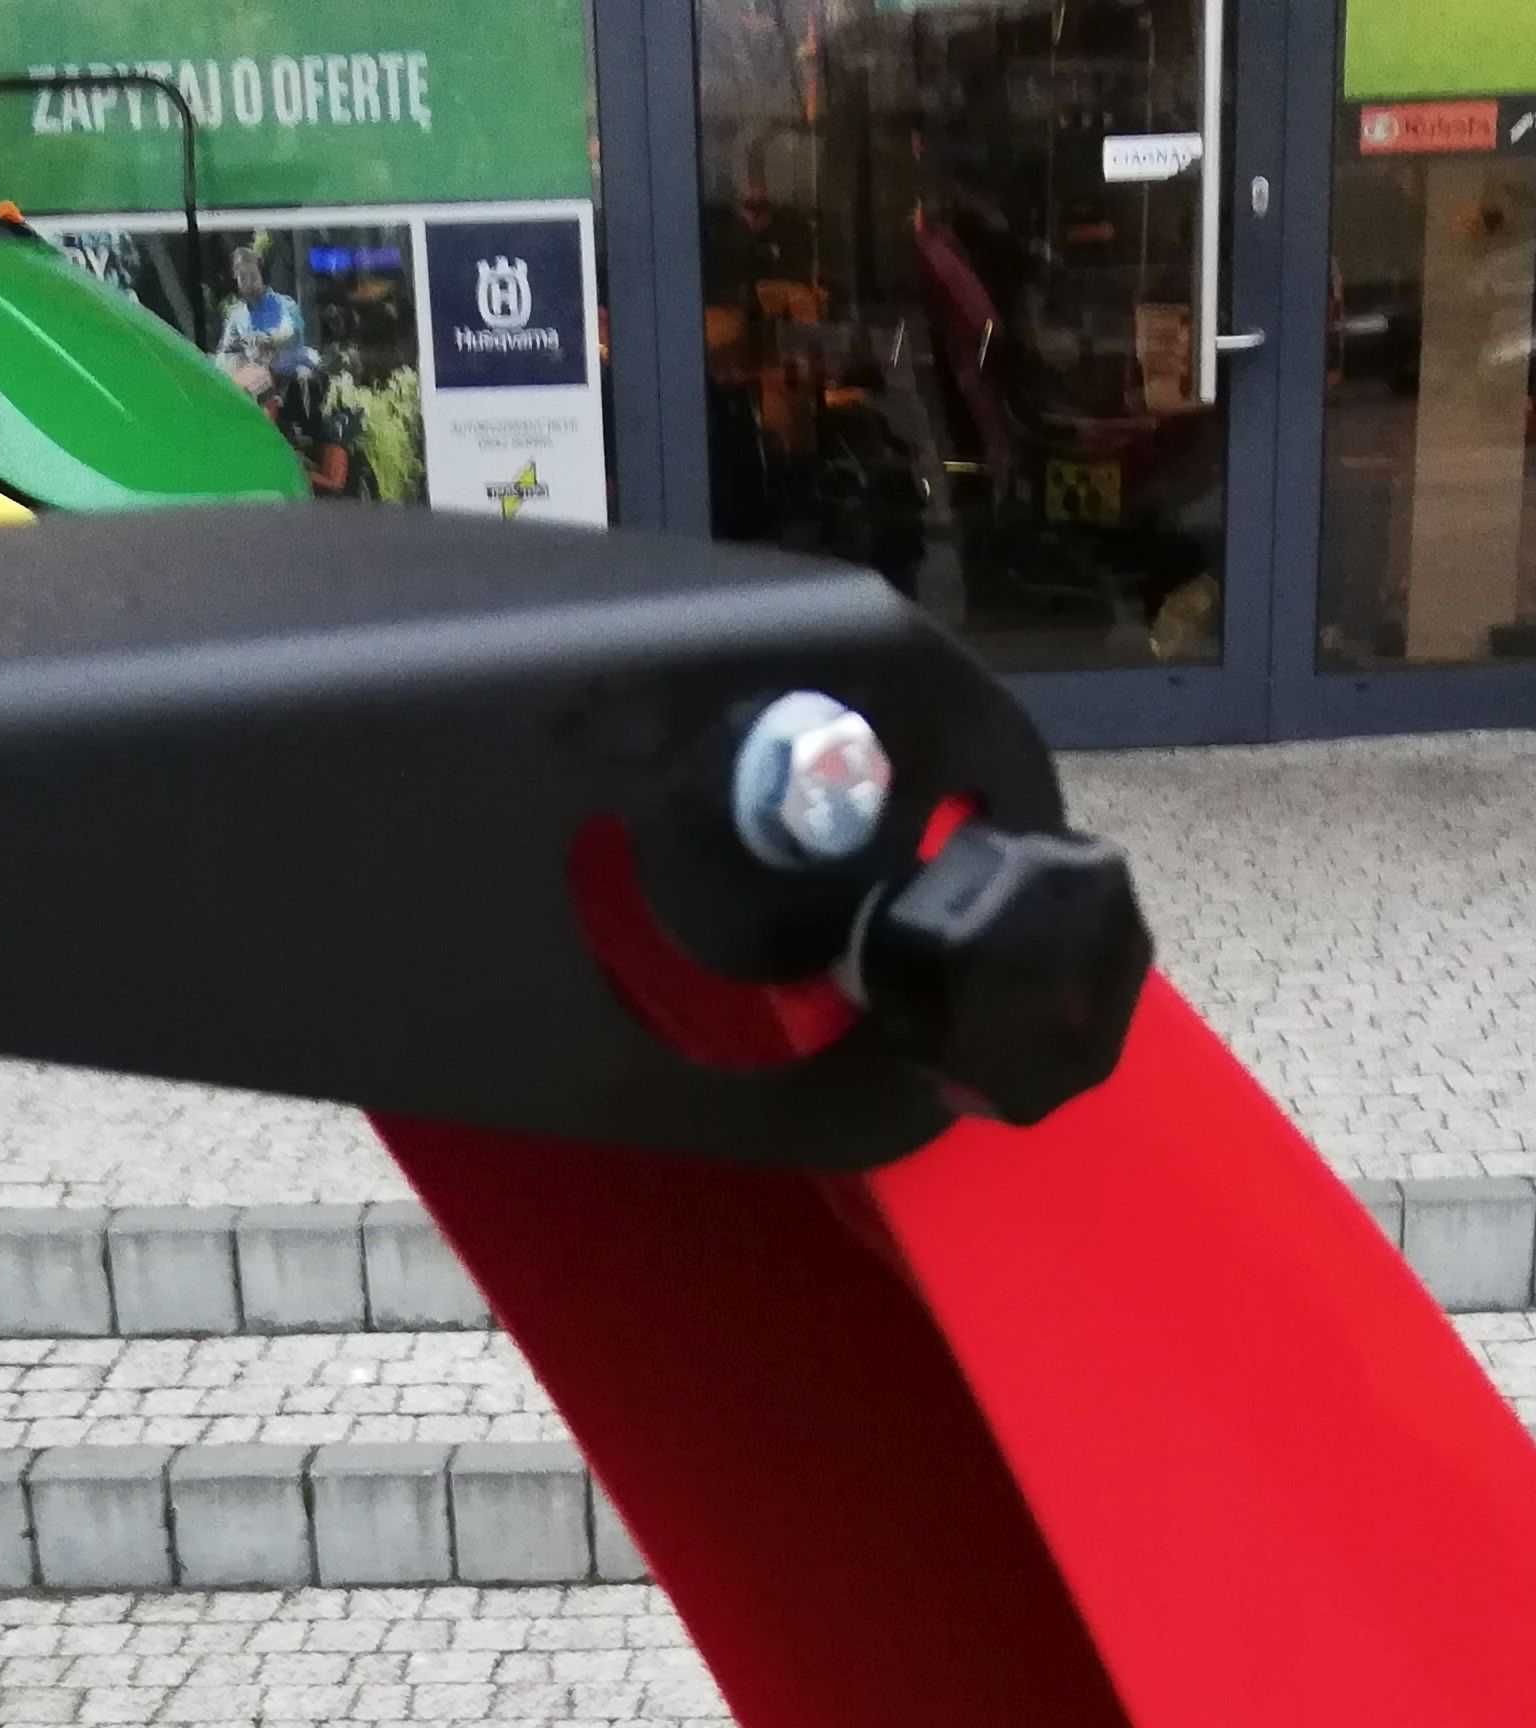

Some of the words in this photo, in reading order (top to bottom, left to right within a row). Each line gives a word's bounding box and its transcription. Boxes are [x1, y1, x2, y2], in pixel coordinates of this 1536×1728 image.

[28, 60, 224, 135] ZAPYTAJ
[232, 54, 263, 127] O
[271, 50, 433, 133] OFERTĘ
